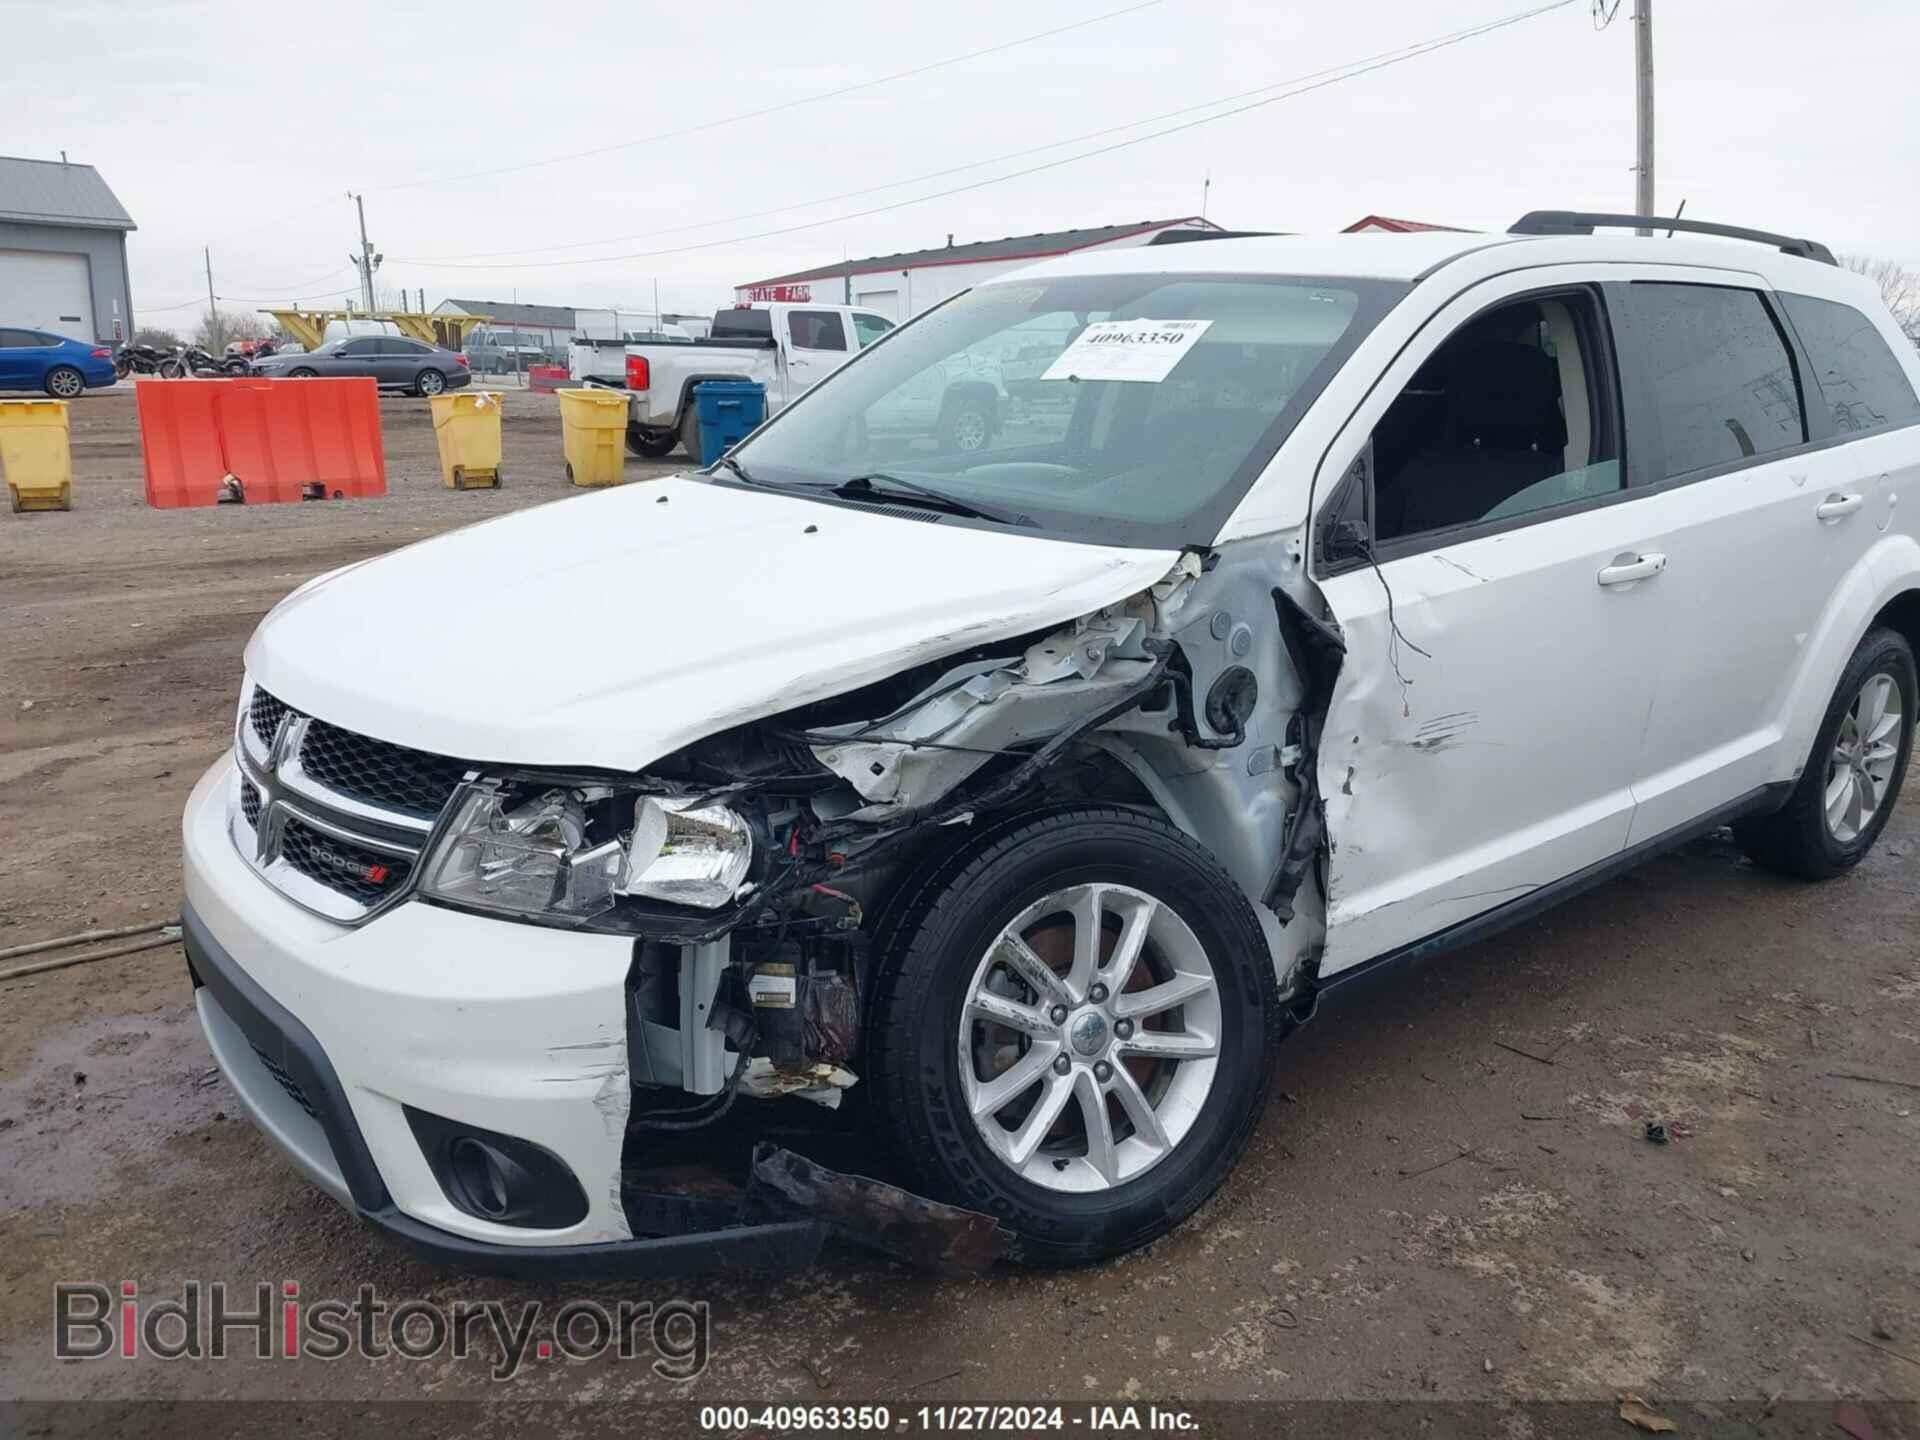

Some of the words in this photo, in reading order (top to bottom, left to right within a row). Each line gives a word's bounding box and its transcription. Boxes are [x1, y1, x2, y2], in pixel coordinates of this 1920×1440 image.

[748, 287, 777, 302] STATE
[785, 285, 810, 303] FARM
[1087, 331, 1185, 345] 40963350
[310, 846, 371, 877] DODGE
